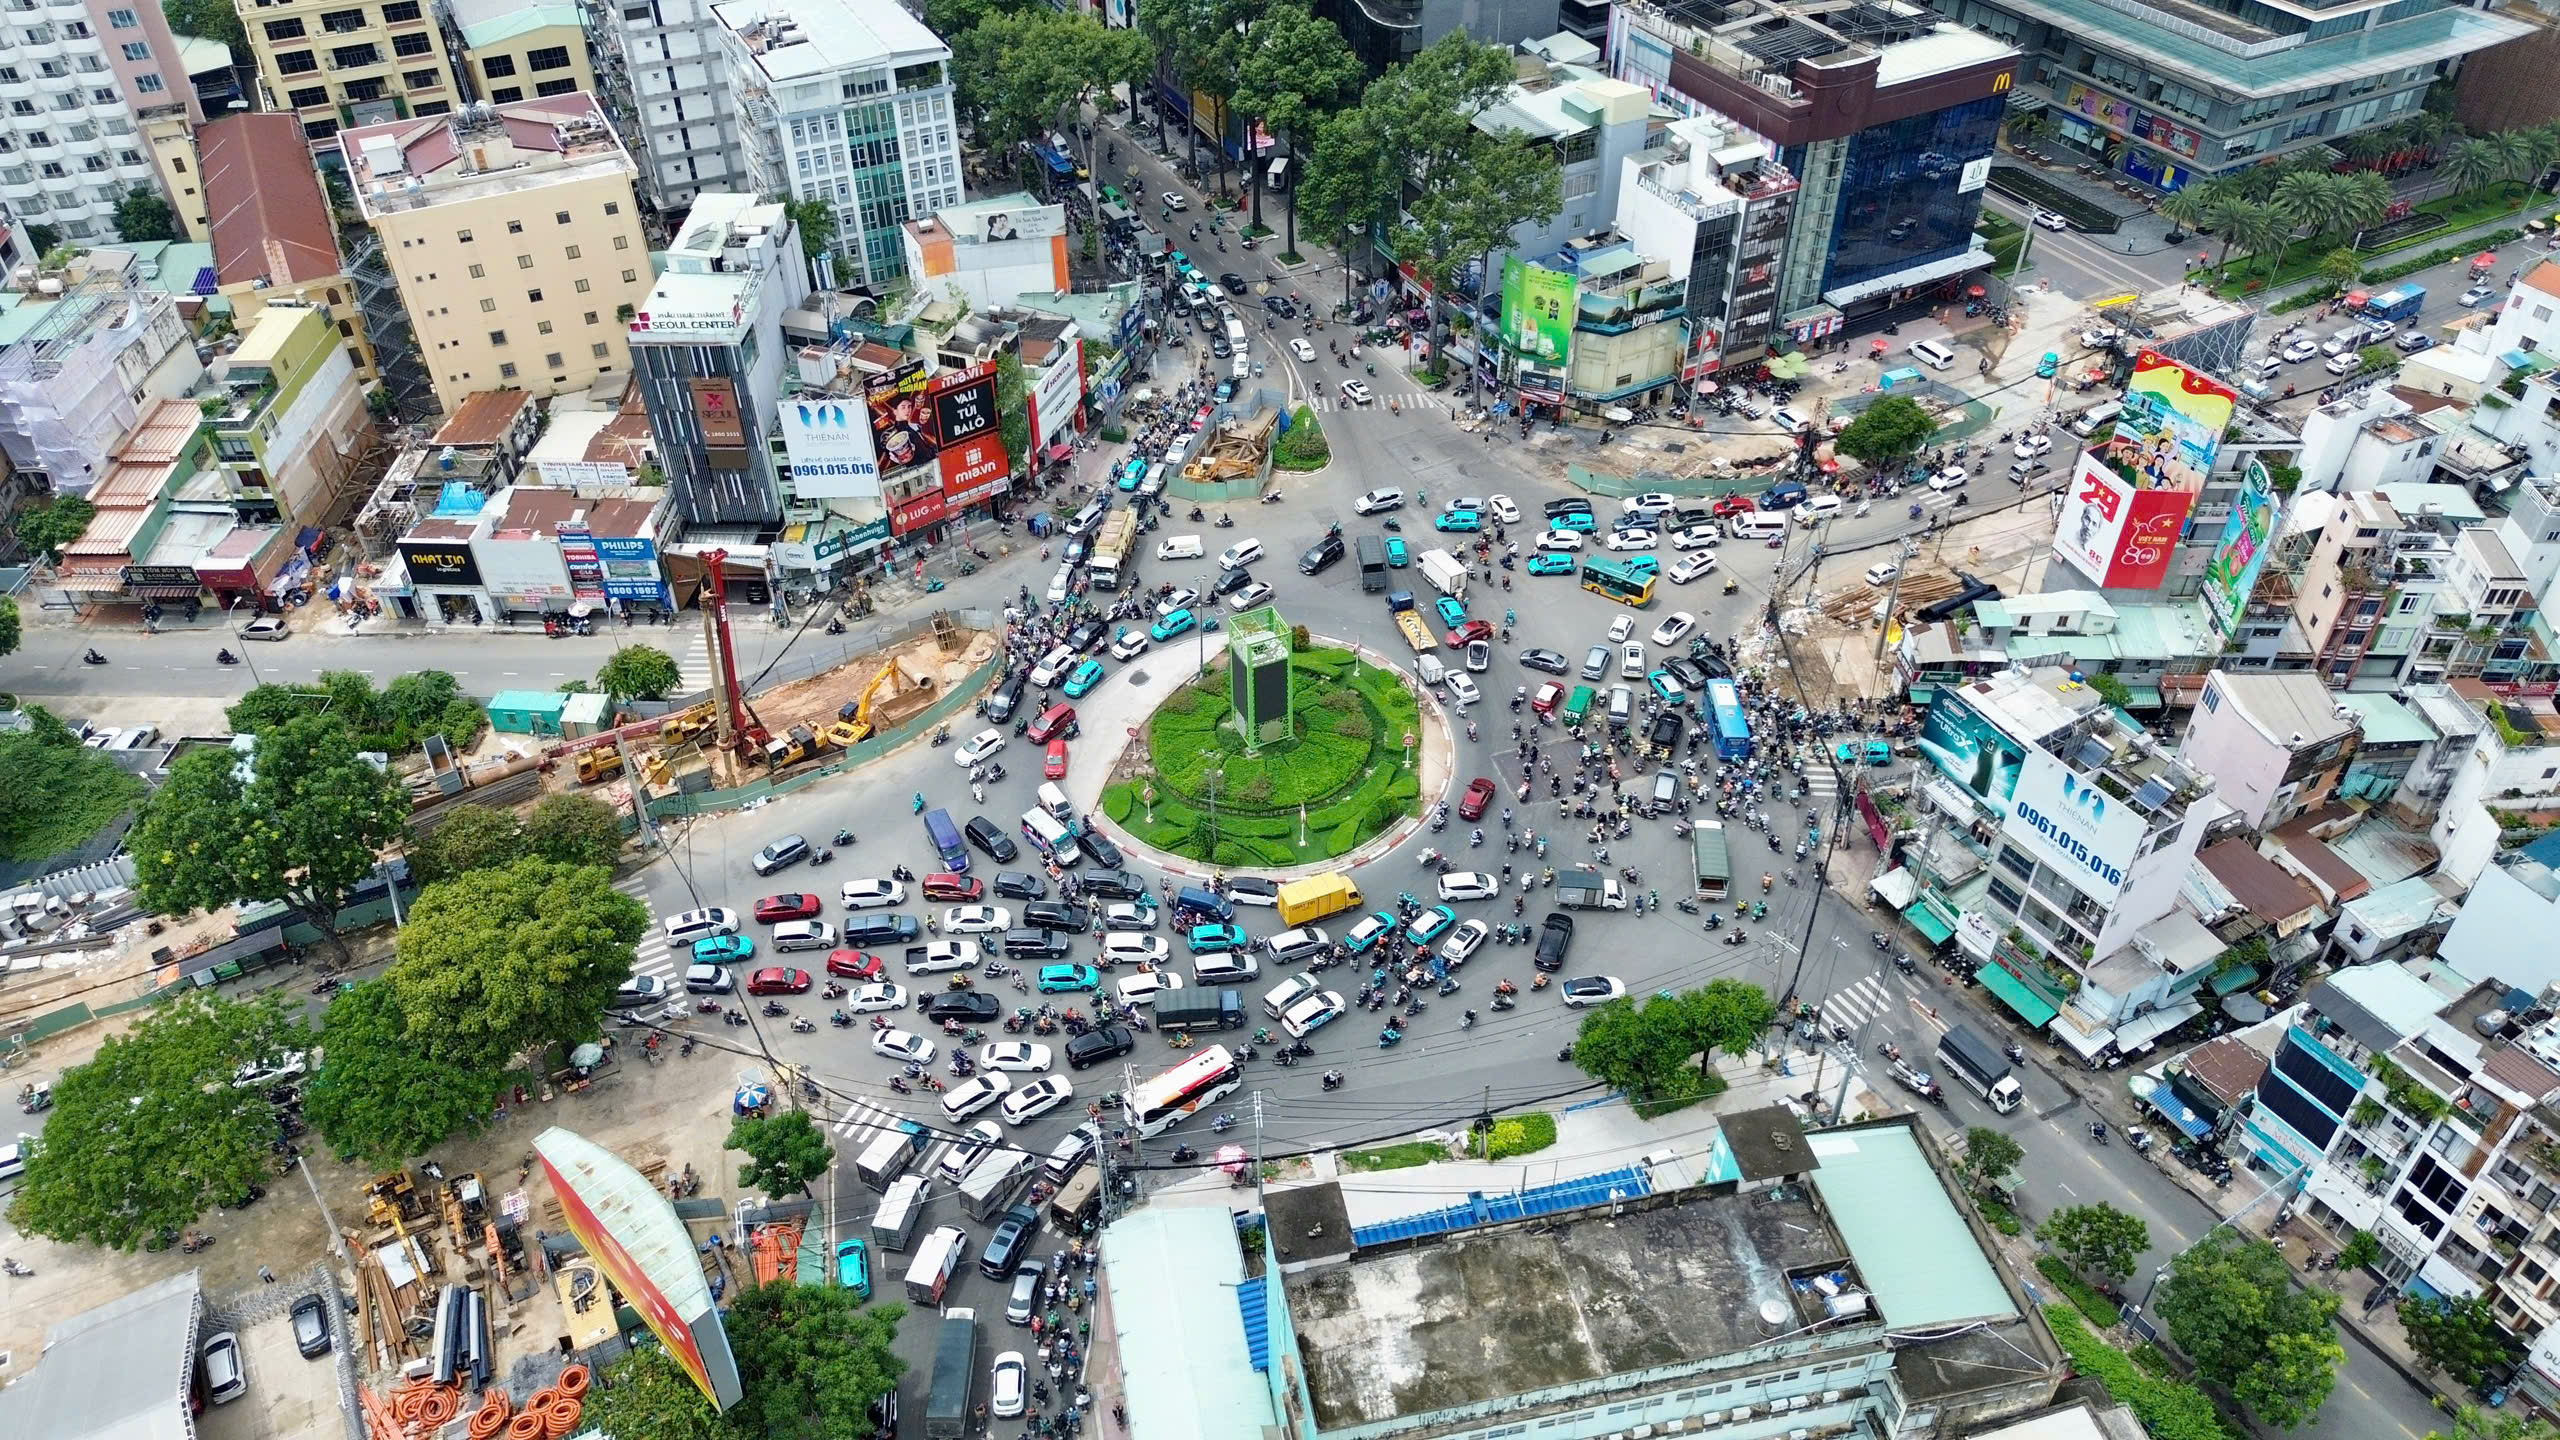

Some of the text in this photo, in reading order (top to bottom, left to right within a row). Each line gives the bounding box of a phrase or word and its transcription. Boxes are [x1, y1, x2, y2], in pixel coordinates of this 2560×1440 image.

[1640, 177, 1658, 195] ANH
[652, 321, 736, 329] SEOUL CENTER
[1632, 309, 1664, 329] KATINAT
[942, 365, 984, 389] mia.vn
[954, 389, 977, 404] VALI
[957, 403, 977, 420] TÚI
[954, 414, 985, 436] BALÔ
[794, 463, 874, 476] 0961.015.016
[955, 461, 996, 484] mia.vn
[2080, 472, 2121, 523] 29
[909, 504, 941, 520] LUG.vn
[601, 542, 644, 550] PHILIPS
[72, 567, 99, 575] WIN
[572, 740, 598, 751] SANY
[2017, 802, 2121, 886] 0961.015.016
[2388, 1233, 2419, 1261] VENUS
